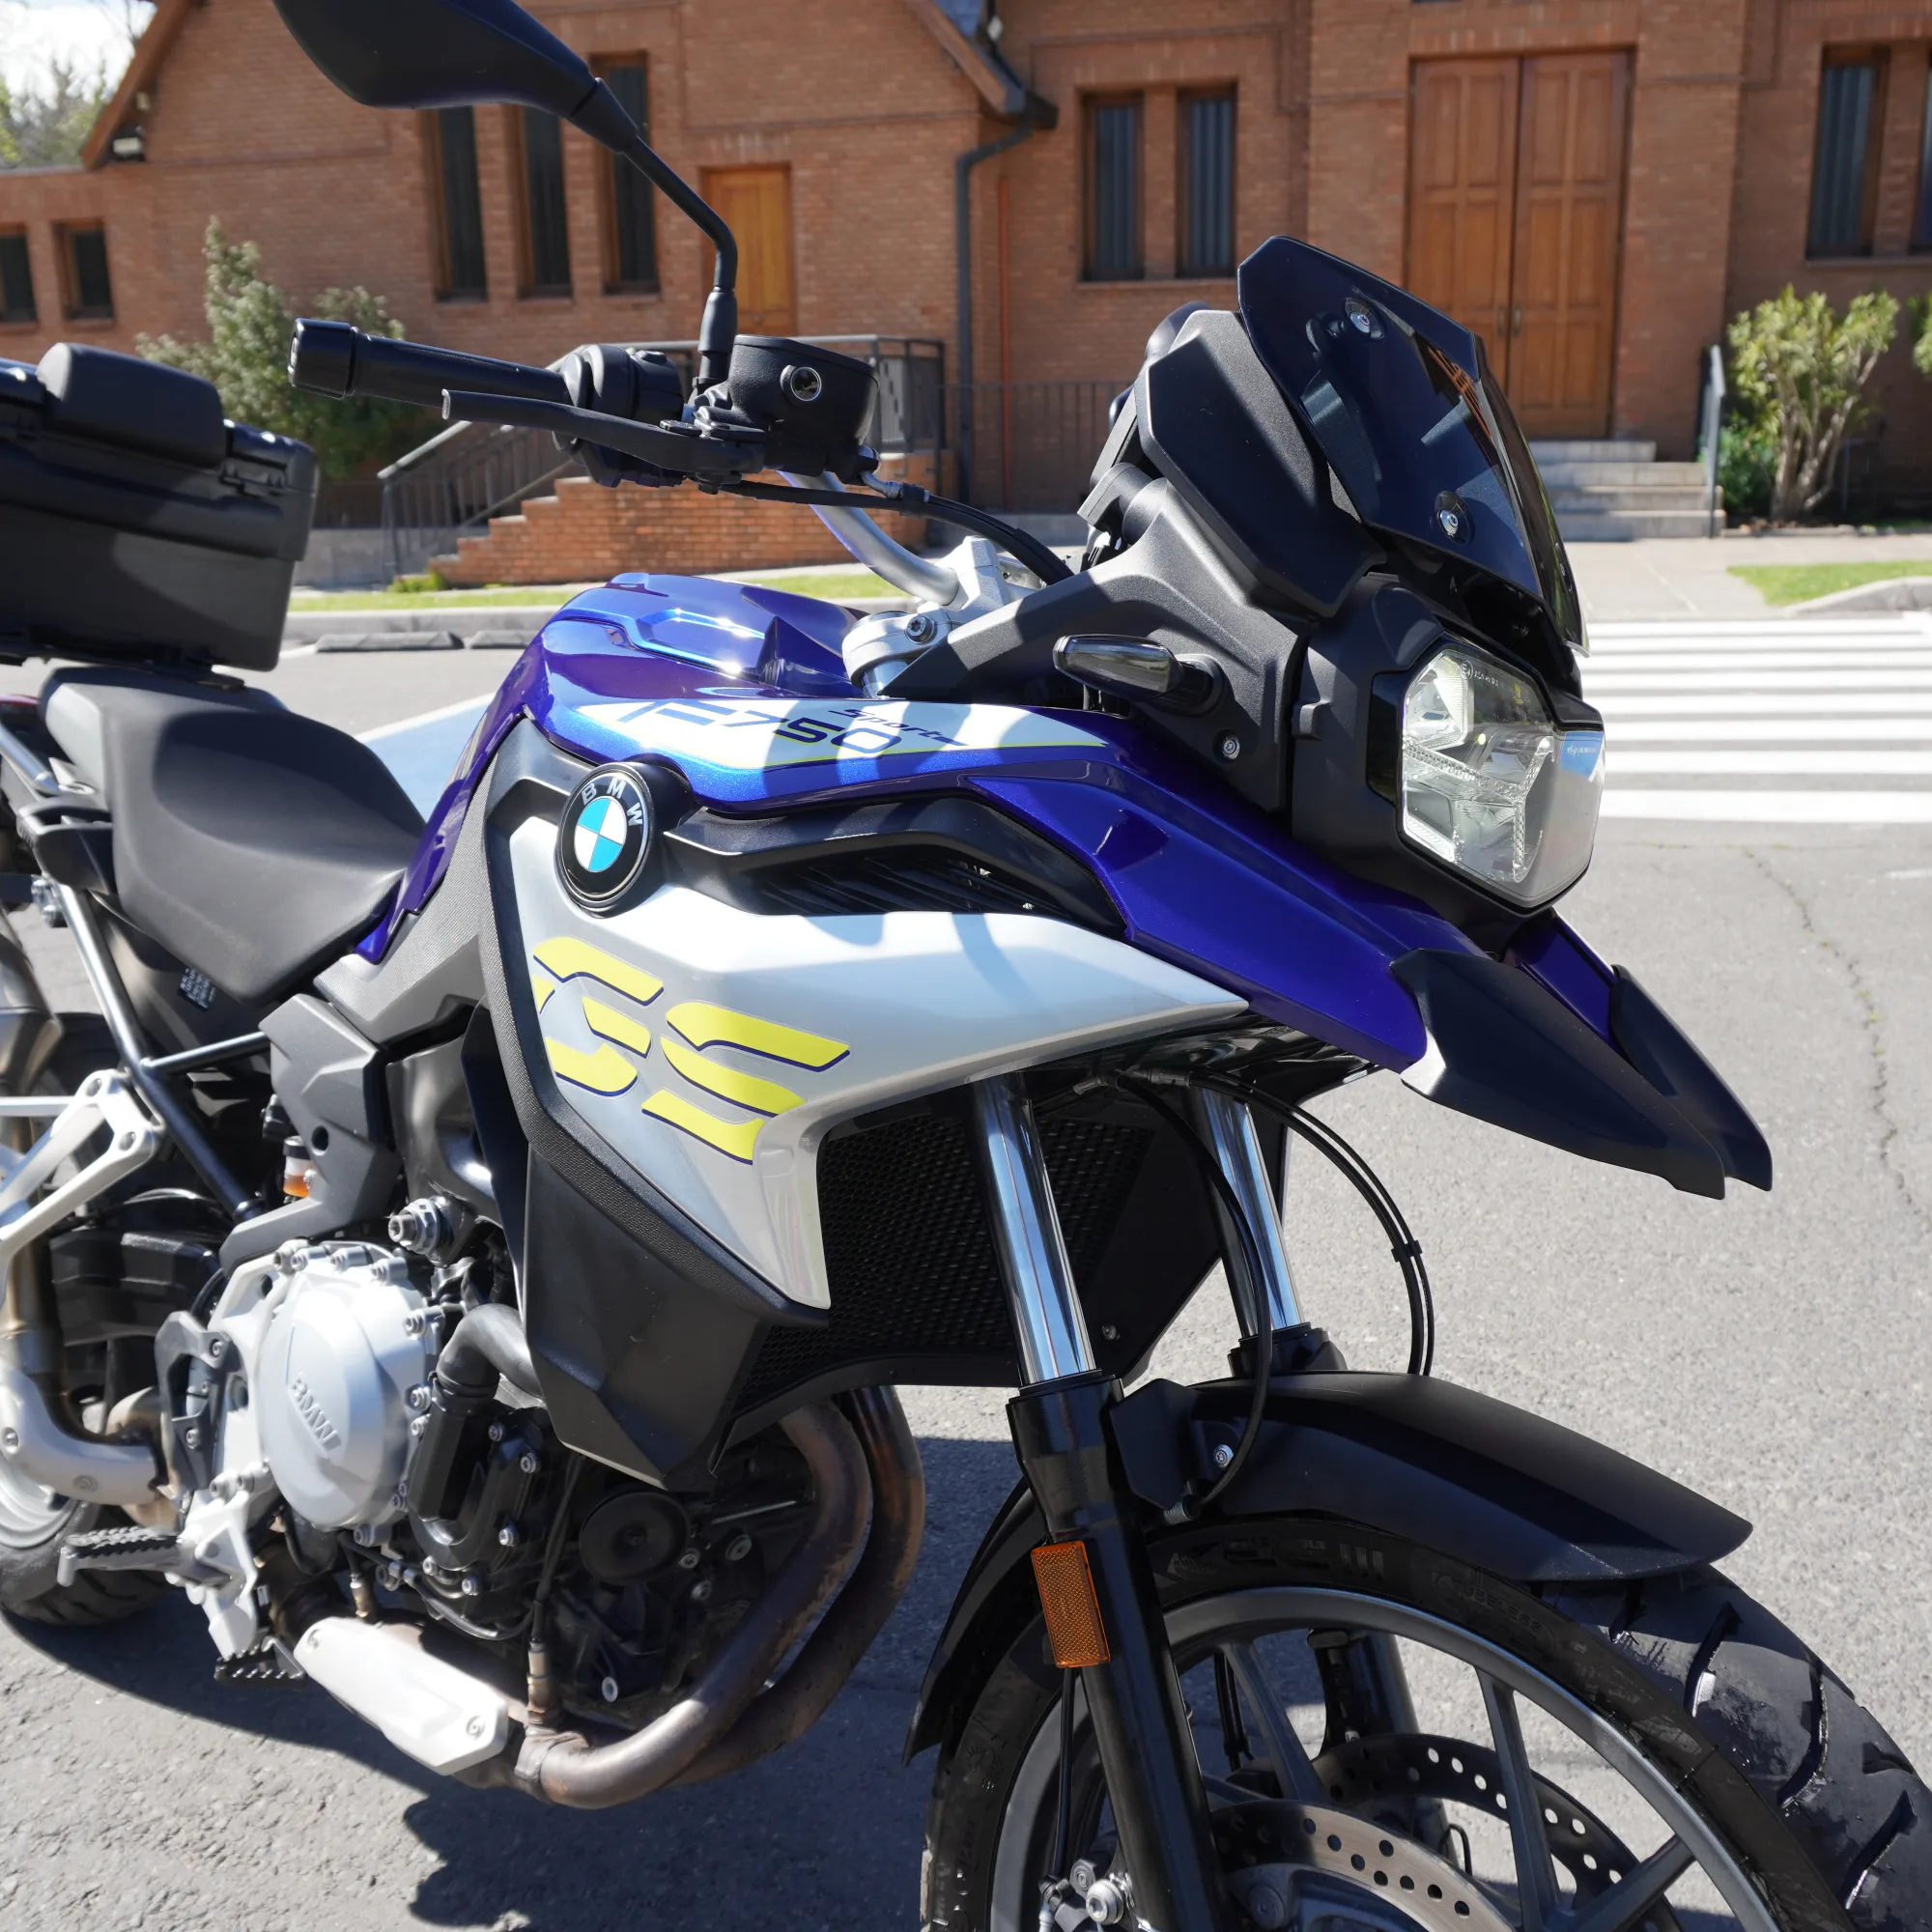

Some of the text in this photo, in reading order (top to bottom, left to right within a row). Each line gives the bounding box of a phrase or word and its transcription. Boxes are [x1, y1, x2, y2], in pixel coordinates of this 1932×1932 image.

[581, 777, 643, 826] BMW
[533, 936, 850, 1165] GS
[292, 1372, 341, 1451] BMW
[1451, 1577, 1544, 1633] TUBELESS
